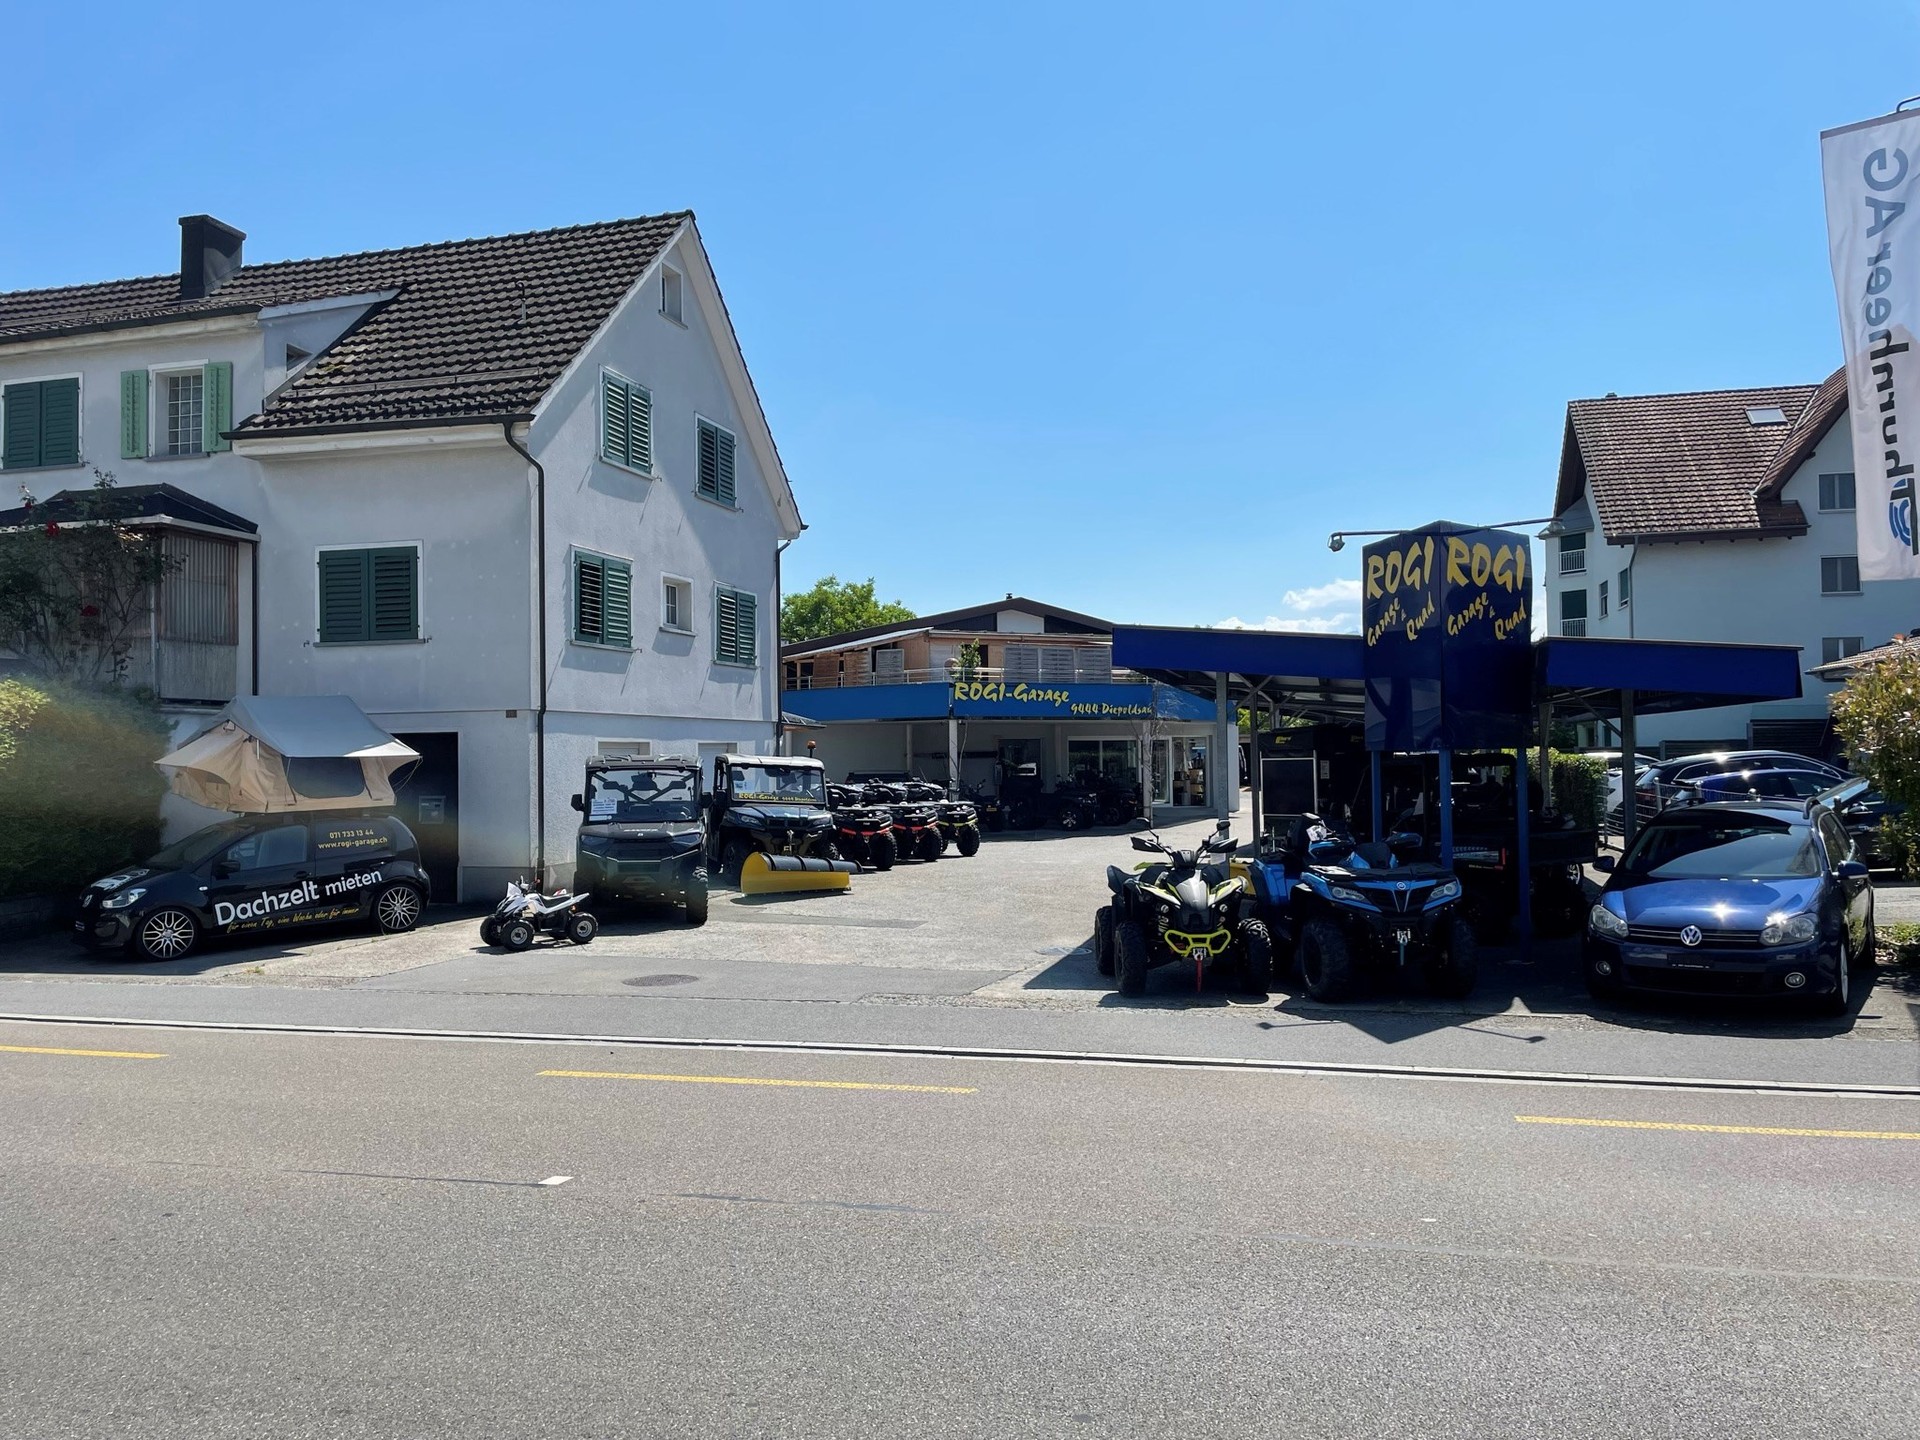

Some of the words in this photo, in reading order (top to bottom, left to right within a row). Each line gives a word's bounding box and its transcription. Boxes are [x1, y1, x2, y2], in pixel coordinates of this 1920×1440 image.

[1366, 536, 1435, 600] ROGI
[1446, 536, 1526, 593] ROGI
[1367, 597, 1401, 647] Garage
[1406, 591, 1436, 641] Quad
[1447, 592, 1489, 636] Garage
[1494, 597, 1527, 641] Quad
[954, 682, 1070, 707] ROGI-Garage
[1070, 703, 1100, 715] 9444
[317, 836, 388, 849] www.rogi-garage.ch
[329, 831, 341, 839] 071
[342, 830, 355, 838] 733
[356, 829, 363, 837] 13
[214, 880, 320, 926] Dachzelt
[325, 870, 383, 897] mieten
